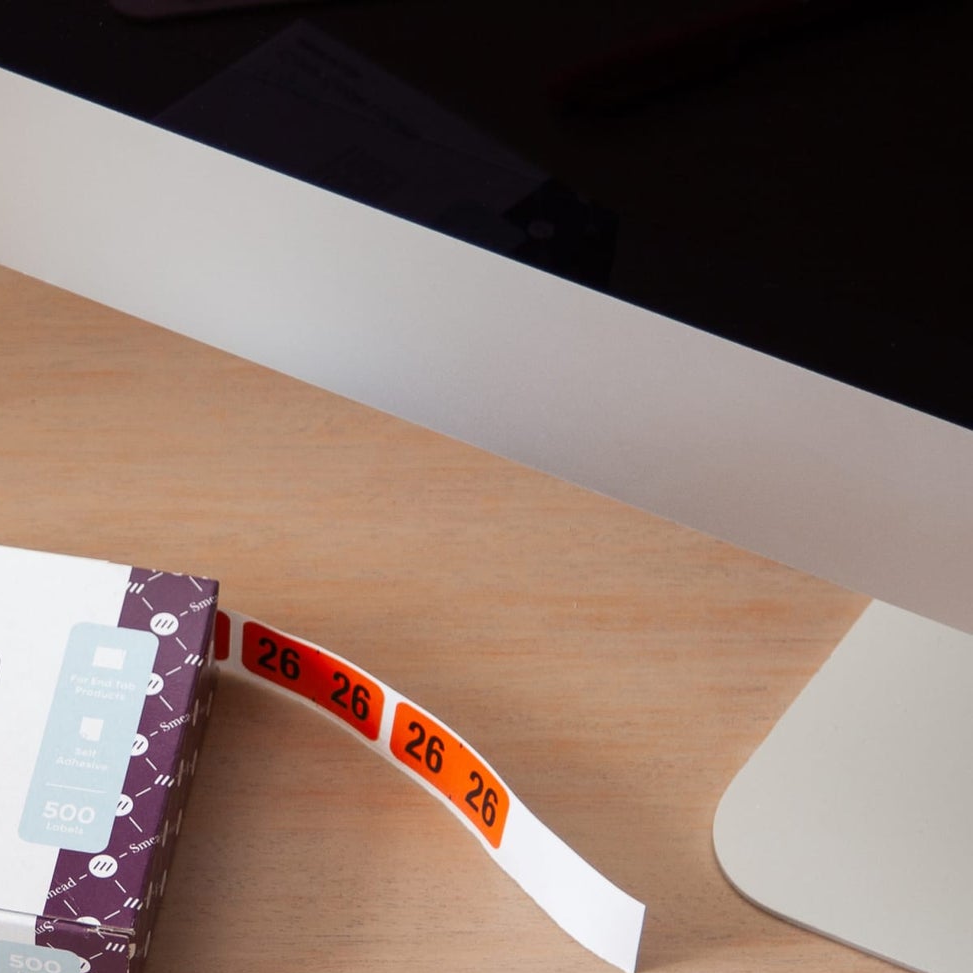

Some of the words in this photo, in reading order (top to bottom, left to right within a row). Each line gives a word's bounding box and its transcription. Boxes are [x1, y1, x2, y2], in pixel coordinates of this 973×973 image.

[257, 637, 300, 680] 26
[330, 671, 371, 721] 26
[404, 721, 445, 774] 26
[465, 771, 499, 827] 26
[42, 799, 96, 825] 500
[47, 877, 77, 900] mead
